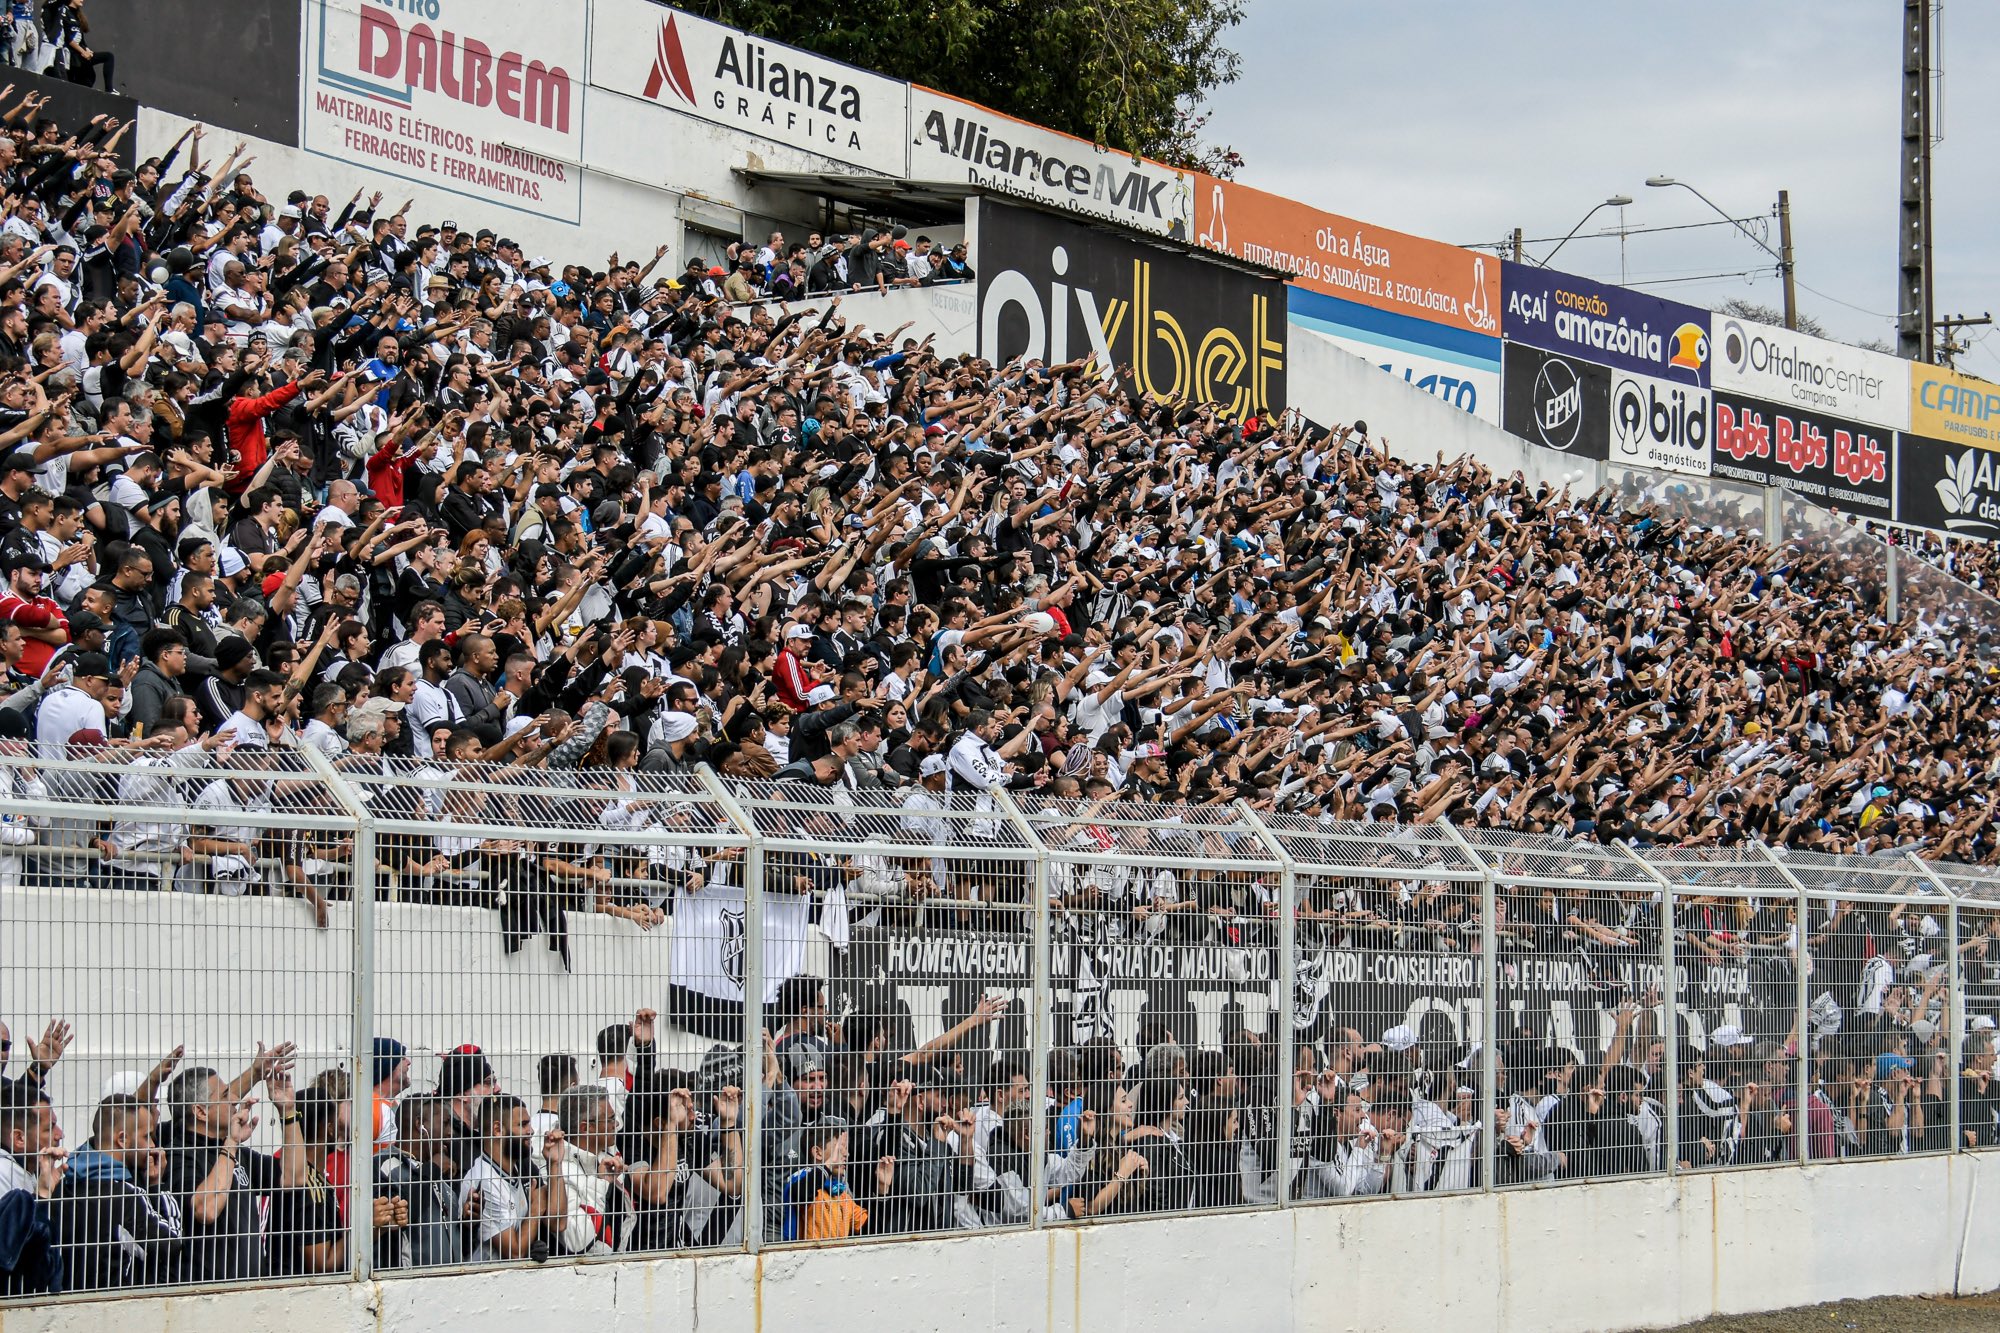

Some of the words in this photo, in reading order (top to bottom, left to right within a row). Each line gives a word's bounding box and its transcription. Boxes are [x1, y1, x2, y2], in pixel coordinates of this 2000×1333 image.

[358, 3, 571, 135] DALBEM
[714, 35, 862, 123] Alianza
[316, 91, 393, 133] MATERIAIS
[713, 90, 861, 151] GRÁFICA
[345, 127, 426, 169] FERRAGENS
[430, 153, 438, 173] E
[443, 157, 543, 202] FERRAMENTAS.
[1340, 240, 1350, 256] a
[1352, 231, 1391, 268] Água
[1323, 264, 1384, 298] SAUDÁVEL
[1386, 281, 1394, 299] &
[1397, 283, 1459, 316] ECOLÓGICA
[1508, 290, 1548, 324] AÇAÍ
[1555, 289, 1608, 317] conexão
[1554, 311, 1662, 363] amazônia
[1750, 336, 1884, 400] Oftalmocenter
[1546, 377, 1581, 430] EPTV
[1649, 384, 1707, 450] bild
[1791, 383, 1838, 408] Campinas
[1716, 403, 1770, 461] Bob's
[1775, 415, 1827, 473] Bob's
[1834, 429, 1886, 486] Bob's
[1944, 420, 1988, 440] PARAFUSOS
[1648, 448, 1707, 471] diagnósticos
[888, 935, 1026, 974] HOMENAGEM
[1150, 946, 1175, 979] DE
[1181, 948, 1269, 980] MAUCIO
[1523, 959, 1531, 991] E
[1702, 966, 1749, 994] JOVEM
